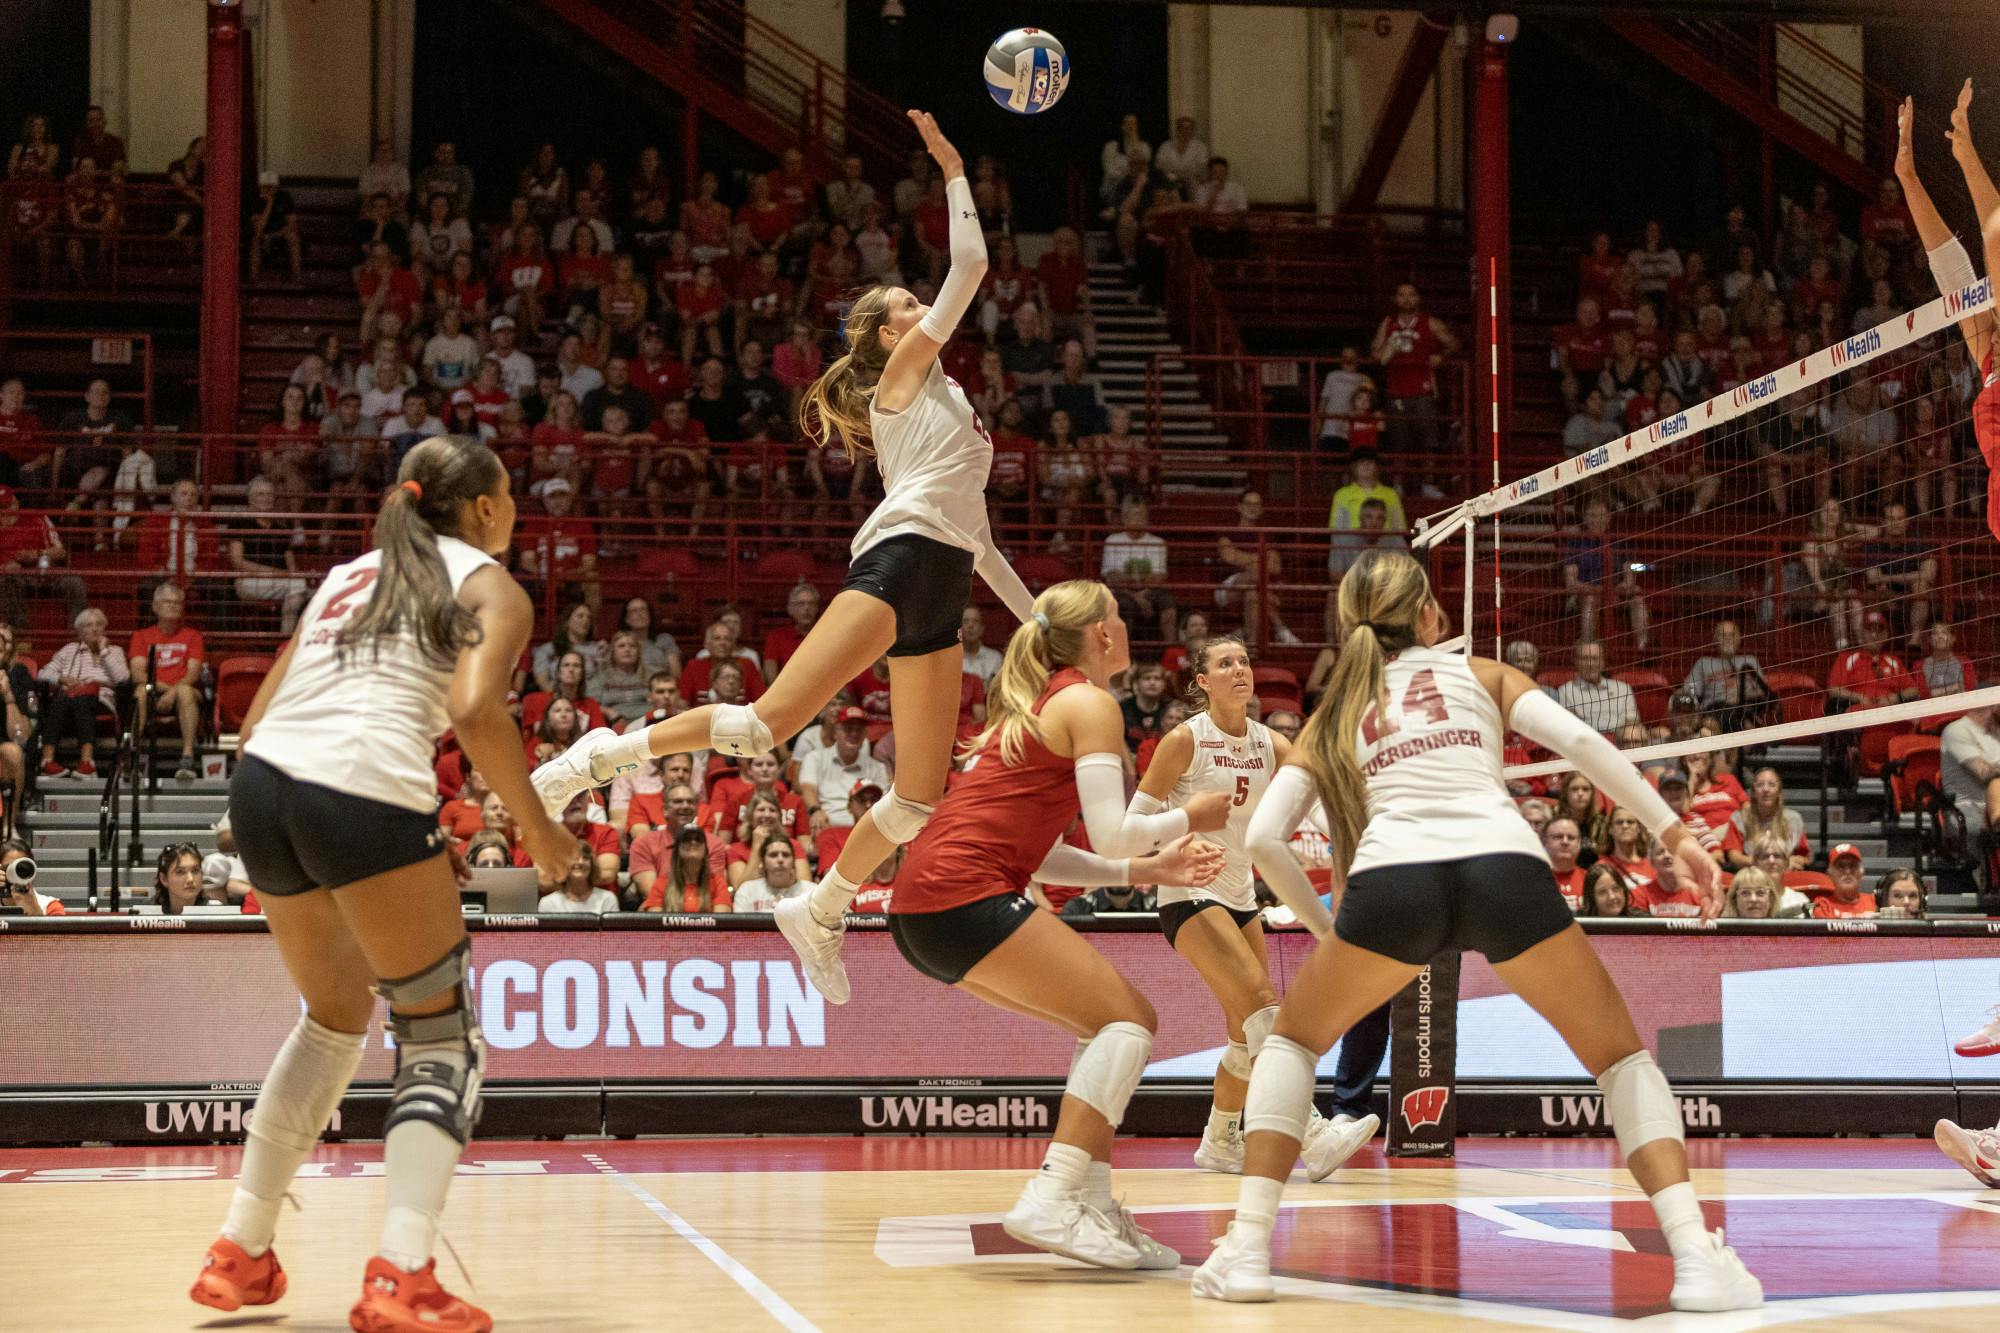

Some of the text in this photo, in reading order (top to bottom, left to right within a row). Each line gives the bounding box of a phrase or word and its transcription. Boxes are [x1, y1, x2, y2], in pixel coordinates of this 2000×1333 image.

[1046, 60, 1060, 105] molten
[1943, 278, 1993, 318] UWHealt
[1831, 328, 1881, 367] UWHealth
[1733, 374, 1777, 408] UWHealth
[1649, 412, 1688, 443] UWHealth
[1575, 446, 1609, 474] UWHealth
[317, 567, 381, 621] 2
[1213, 755, 1264, 770] WISCONSIN
[1361, 729, 1482, 777] UERBRINGER
[1233, 776, 1249, 806] 5
[130, 919, 186, 928] UWHealth
[484, 916, 539, 926] UWHealth
[662, 916, 716, 926] UWHealth
[1827, 921, 1877, 932] UWHealth
[302, 959, 826, 1049] CONSIN
[1416, 1016, 1433, 1078] imports
[860, 1097, 1048, 1127] UWHealth
